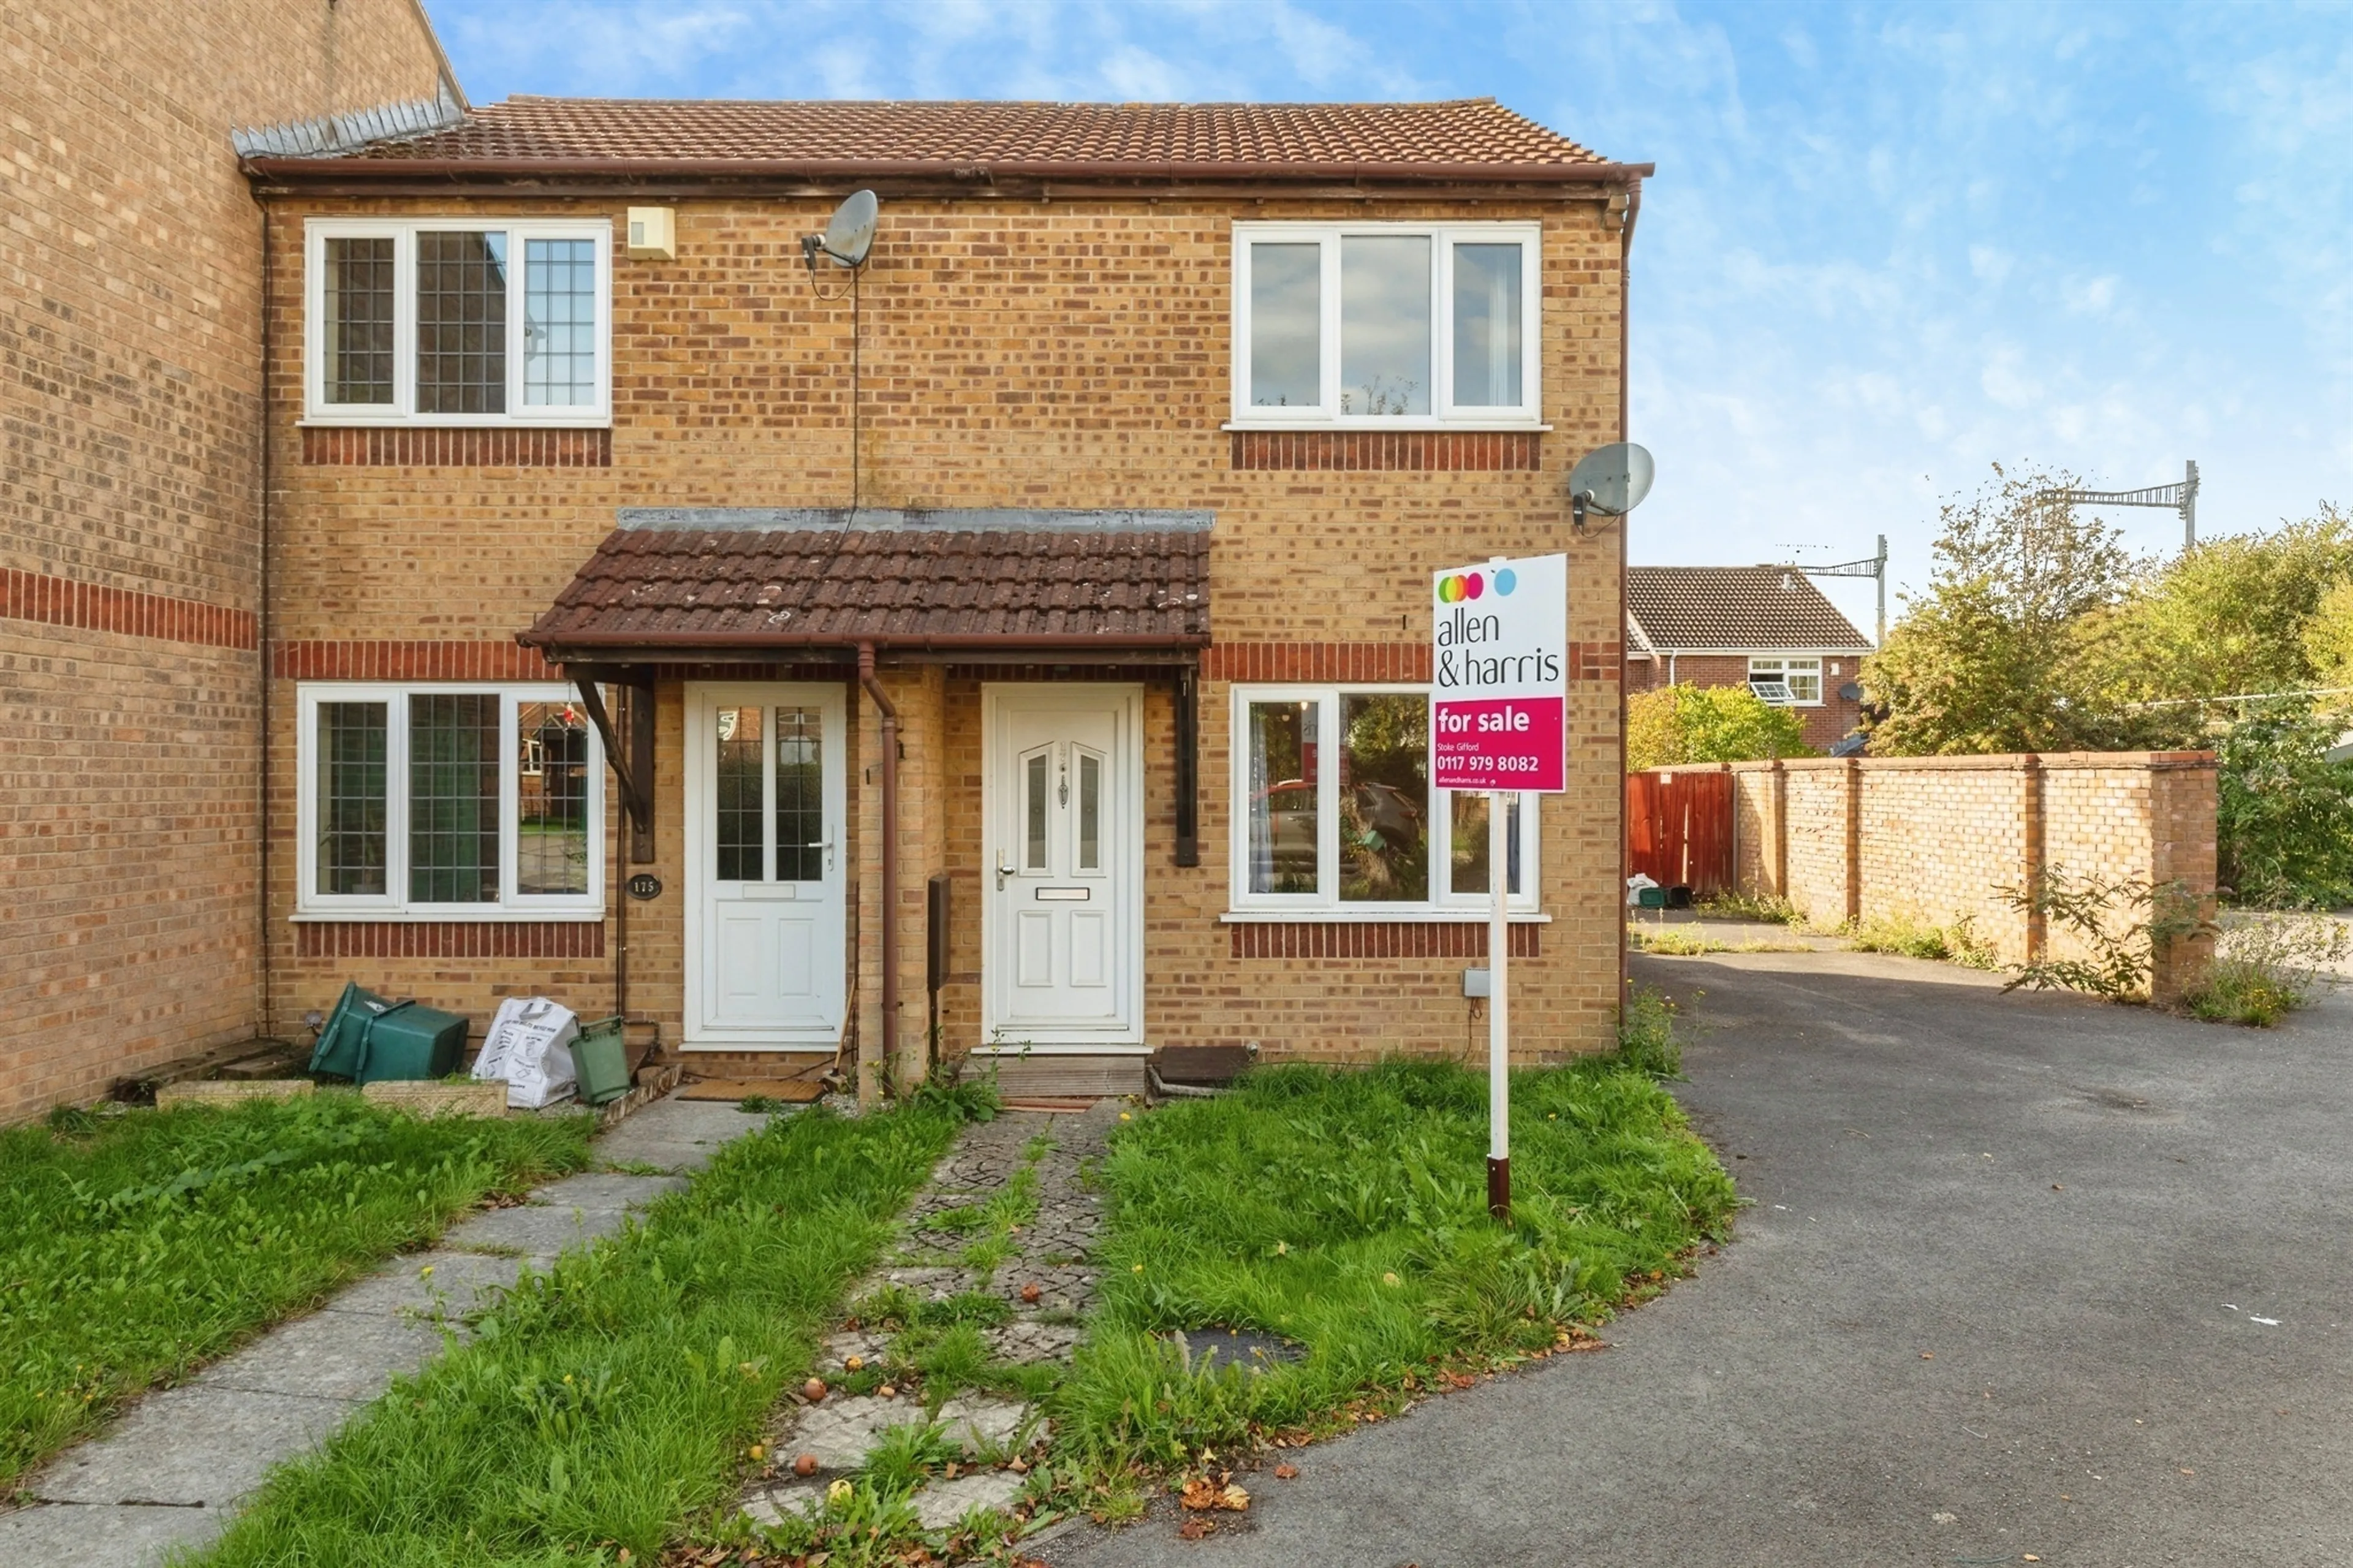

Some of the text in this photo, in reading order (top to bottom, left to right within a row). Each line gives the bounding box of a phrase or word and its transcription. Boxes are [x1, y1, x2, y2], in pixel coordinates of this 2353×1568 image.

[1438, 607, 1499, 647] allen
[1438, 648, 1559, 687] & harris
[1438, 705, 1530, 733] for sale
[1437, 742, 1479, 752] Stoke Gifford
[1437, 756, 1539, 772] 0117 979 8082
[1438, 776, 1487, 784] allenandharris.co.uk
[634, 881, 654, 892] 175
